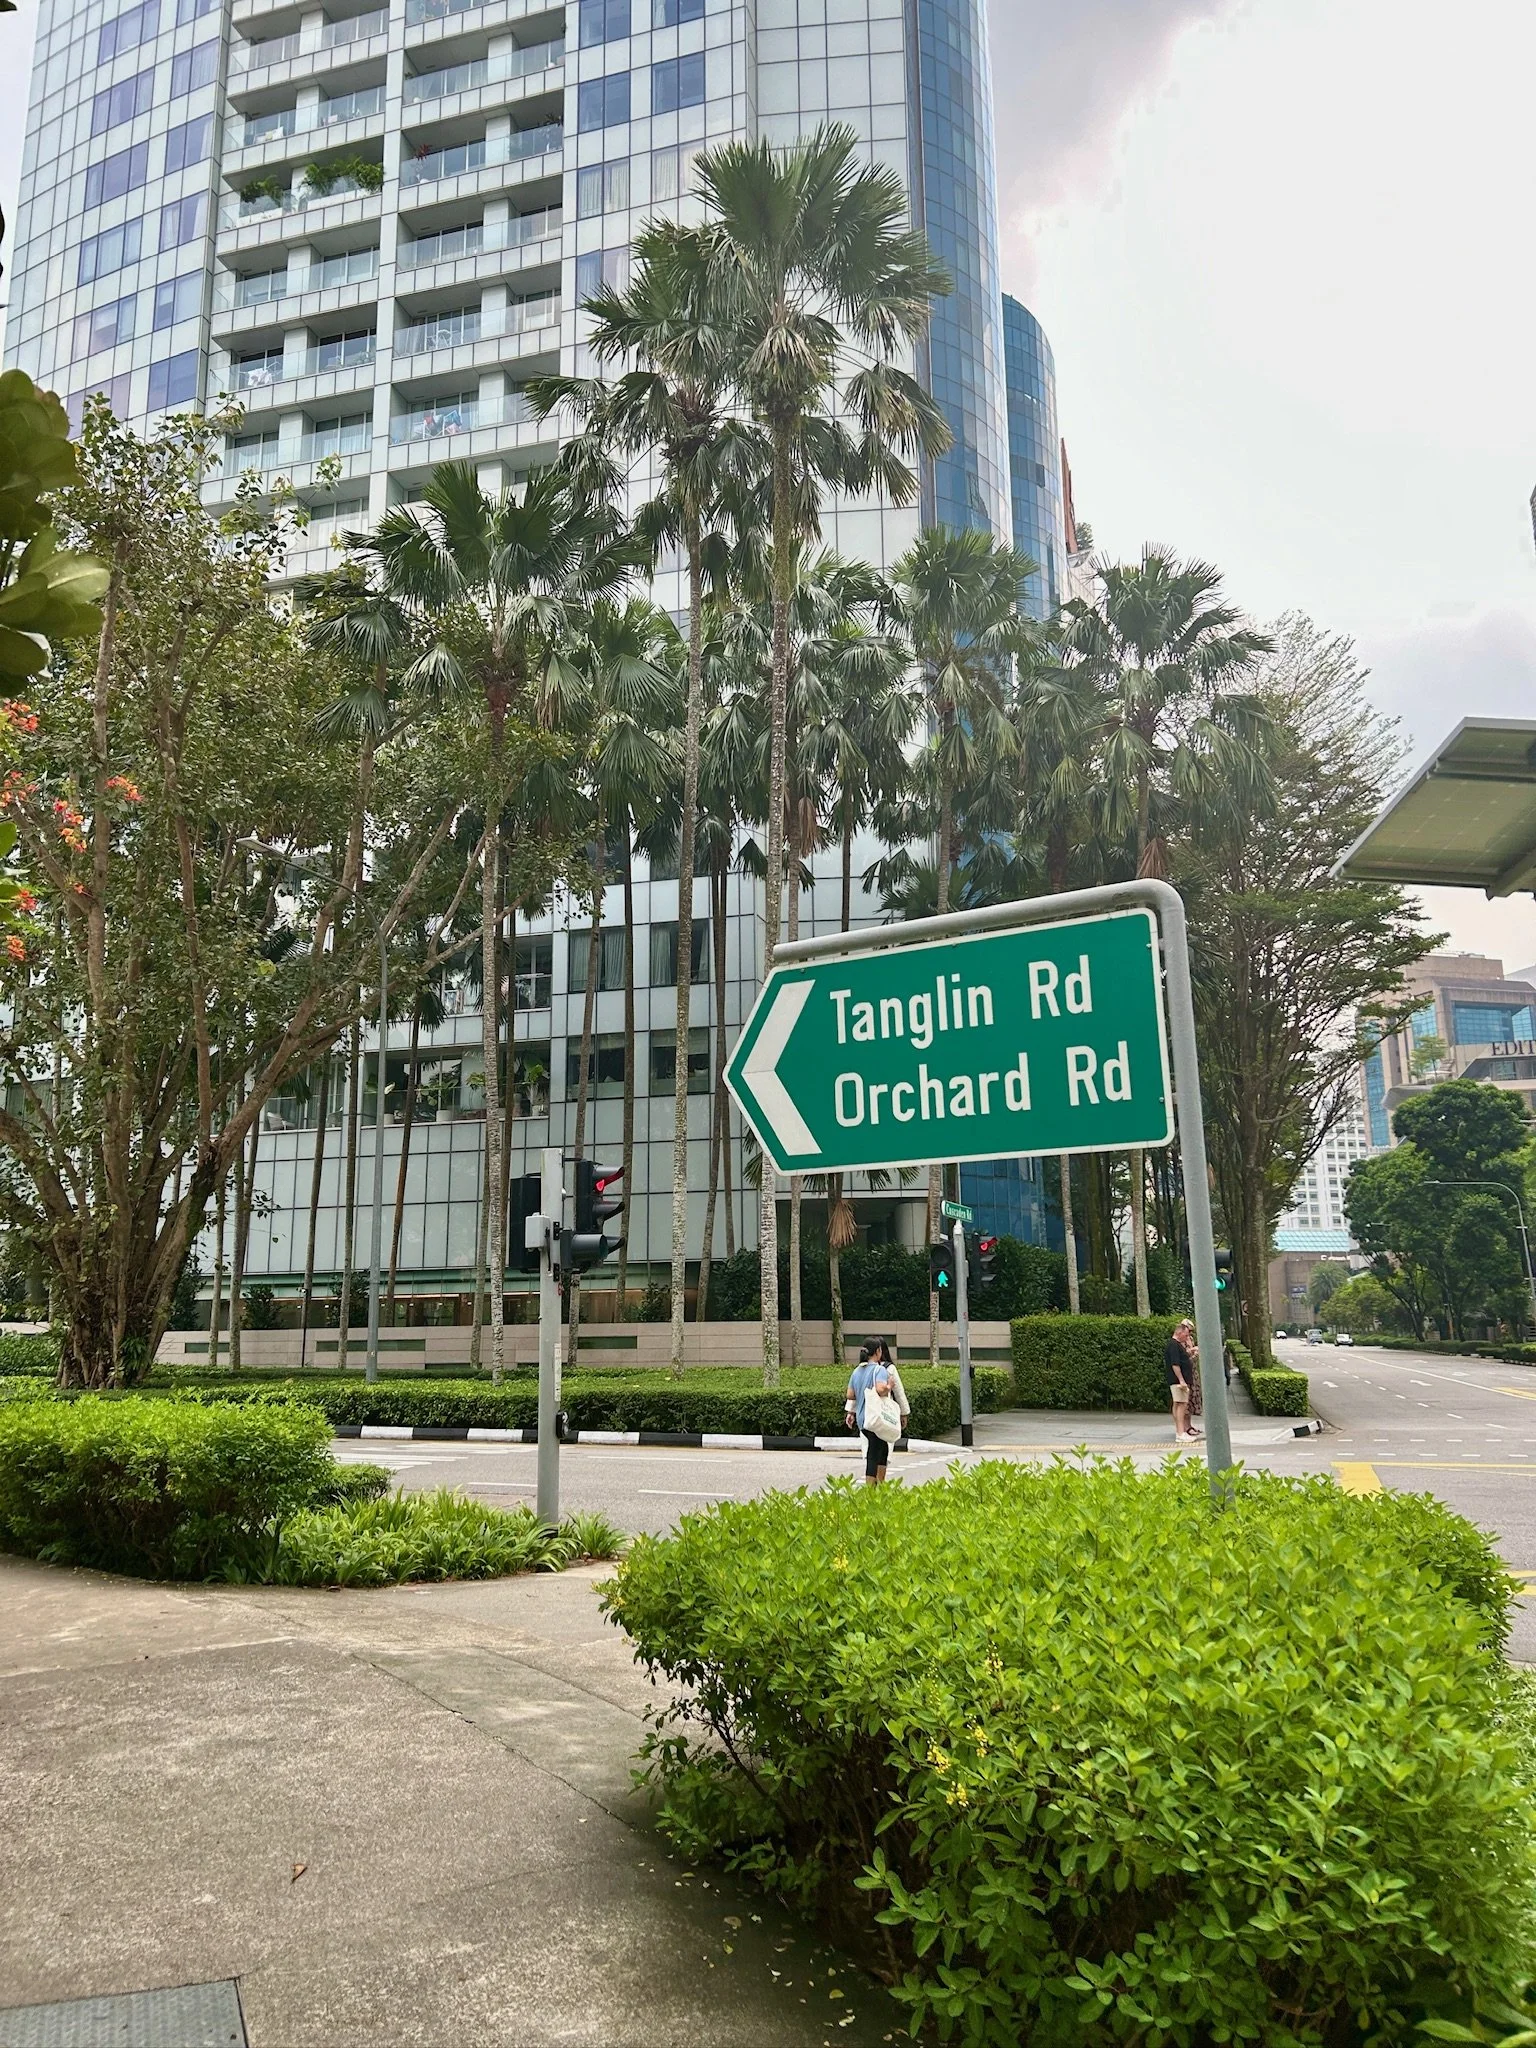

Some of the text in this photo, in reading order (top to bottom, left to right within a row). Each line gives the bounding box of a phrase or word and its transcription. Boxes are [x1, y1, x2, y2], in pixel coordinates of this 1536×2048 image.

[830, 955, 1093, 1049] Tanglin Rd
[834, 1041, 1131, 1127] Orchard Rd
